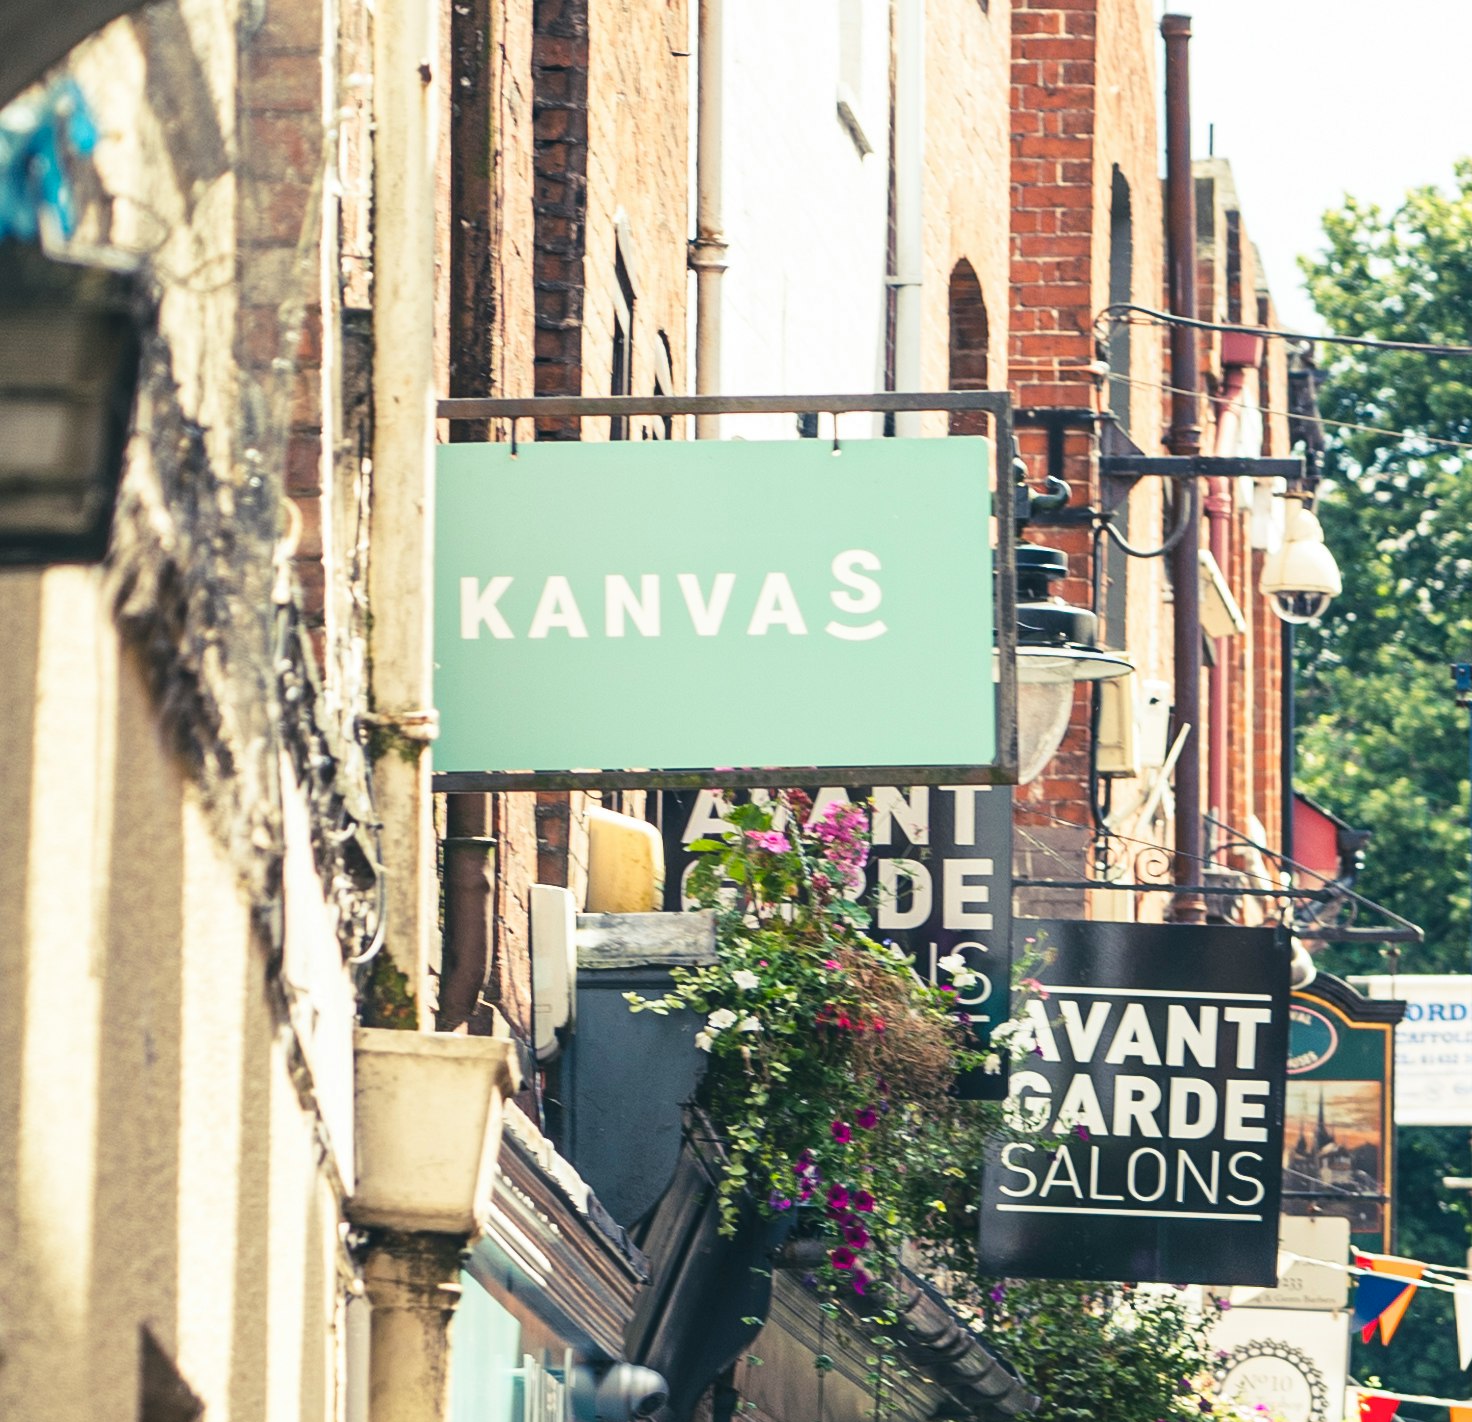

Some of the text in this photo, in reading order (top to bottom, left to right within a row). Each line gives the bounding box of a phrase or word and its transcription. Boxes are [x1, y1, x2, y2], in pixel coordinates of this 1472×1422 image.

[460, 550, 888, 641] KANVAS
[1010, 999, 1272, 1071] AVANT
[1003, 1074, 1271, 1143] GARDE
[999, 1142, 1265, 1207] SALONS
